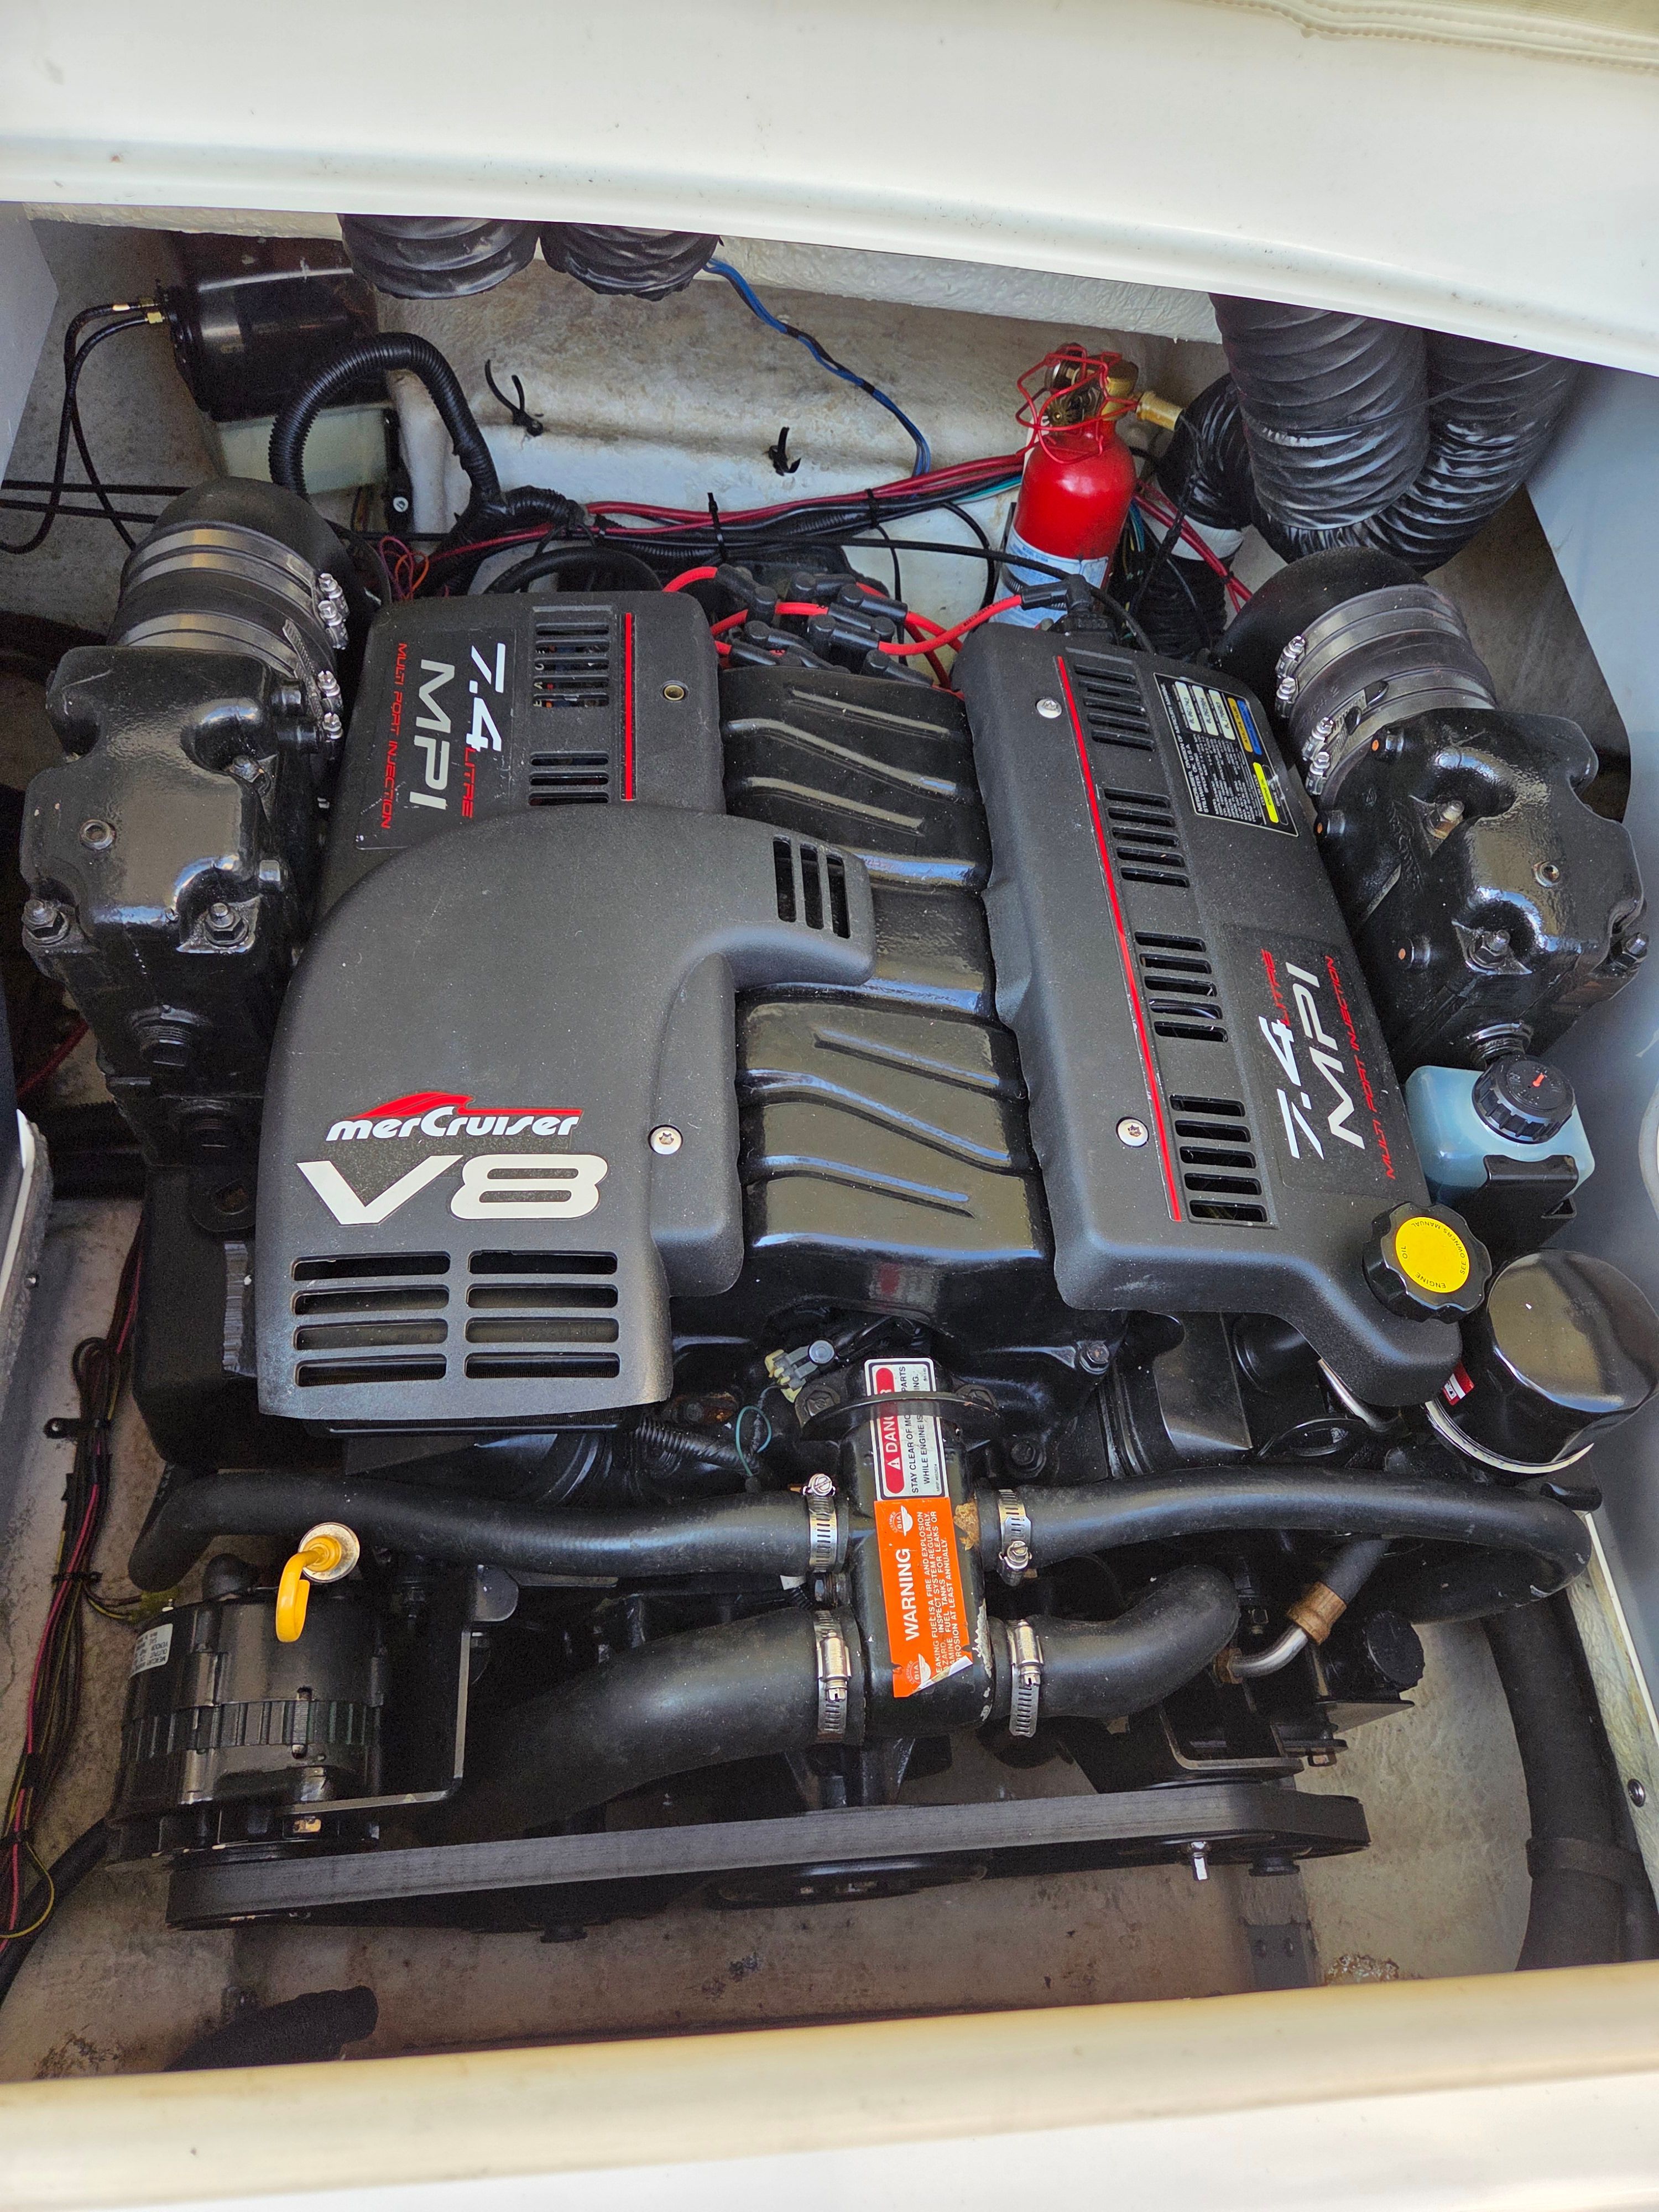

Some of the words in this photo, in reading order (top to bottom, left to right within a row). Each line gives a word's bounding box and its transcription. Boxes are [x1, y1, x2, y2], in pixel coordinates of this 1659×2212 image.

[394, 643, 408, 685] MULTI
[389, 690, 403, 735] PORT
[466, 643, 505, 752] 7.4
[409, 659, 456, 810] MPI
[382, 740, 397, 830] INJECTION
[461, 748, 477, 818] LITRE
[1261, 948, 1291, 1026] LITRE
[1325, 955, 1360, 1051] INJECTION
[1285, 962, 1365, 1150] MPI
[1258, 1015, 1324, 1160] 7.4
[1354, 1054, 1378, 1113] PORT
[325, 1105, 579, 1142] merCruiser
[1373, 1118, 1396, 1180] MULTI
[296, 1154, 609, 1225] V8
[1411, 1220, 1441, 1229] MANUAL
[1443, 1228, 1465, 1258] OWNERS
[1415, 1271, 1446, 1288] ENGINE
[899, 1366, 908, 1392] PARTS
[906, 1428, 913, 1440] OF
[918, 1427, 927, 1455] ENGINE
[906, 1442, 916, 1470] CLEAR
[921, 1459, 930, 1484] WHILE
[909, 1474, 919, 1493] STAY
[917, 1511, 928, 1557] EXPLOSION
[924, 1511, 935, 1559] REGULARLY.
[930, 1511, 937, 1523] OR
[932, 1526, 941, 1552] LEAKS
[941, 1537, 952, 1580] ANNUALLY.
[895, 1548, 920, 1641] WARNING
[930, 1561, 940, 1594] SYSTEM
[939, 1579, 948, 1606] TANKS
[946, 1583, 956, 1608] LEAST
[929, 1617, 938, 1638] FUEL
[935, 1597, 944, 1633] INSPECT
[950, 1610, 957, 1620] AT
[933, 1640, 942, 1673] EAKING
[947, 1638, 955, 1665] AMINE
